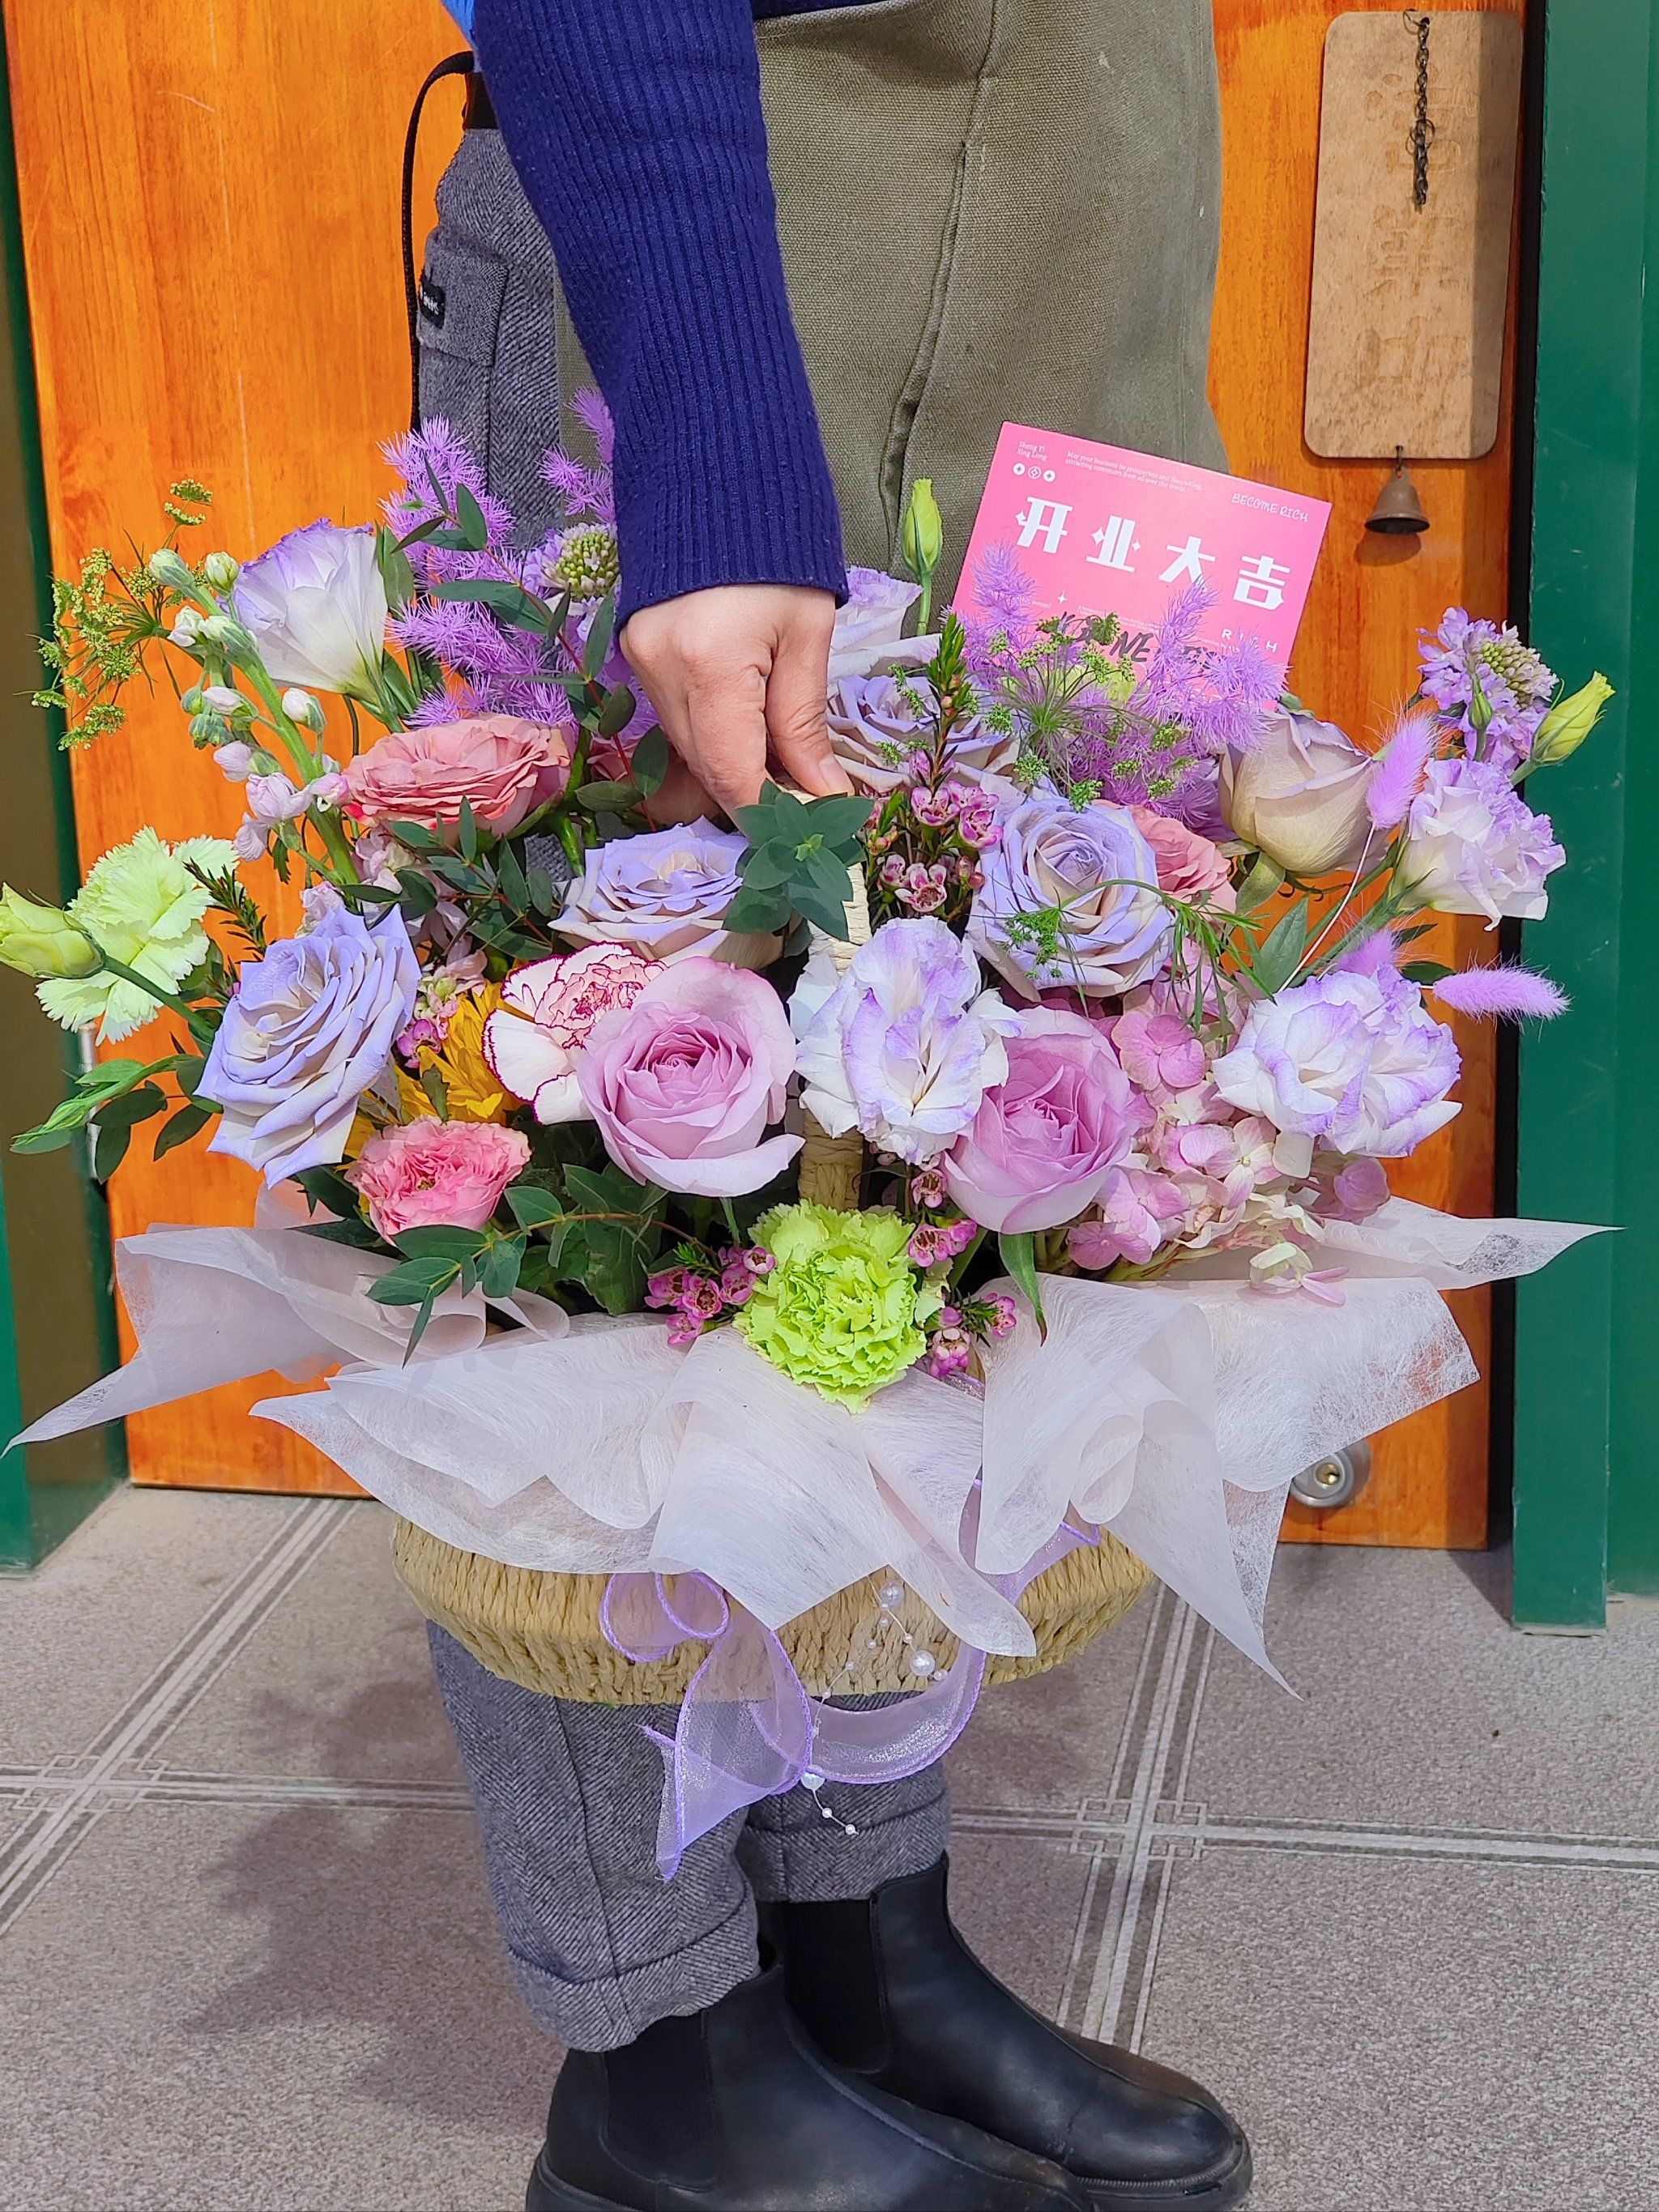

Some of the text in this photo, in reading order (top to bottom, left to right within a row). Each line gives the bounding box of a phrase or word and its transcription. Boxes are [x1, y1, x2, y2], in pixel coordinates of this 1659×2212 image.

[1018, 441, 1038, 452] Sheng
[1030, 451, 1047, 462] Long
[1231, 492, 1309, 522] BECOME RICH
[1014, 496, 1291, 611] 开业大吉
